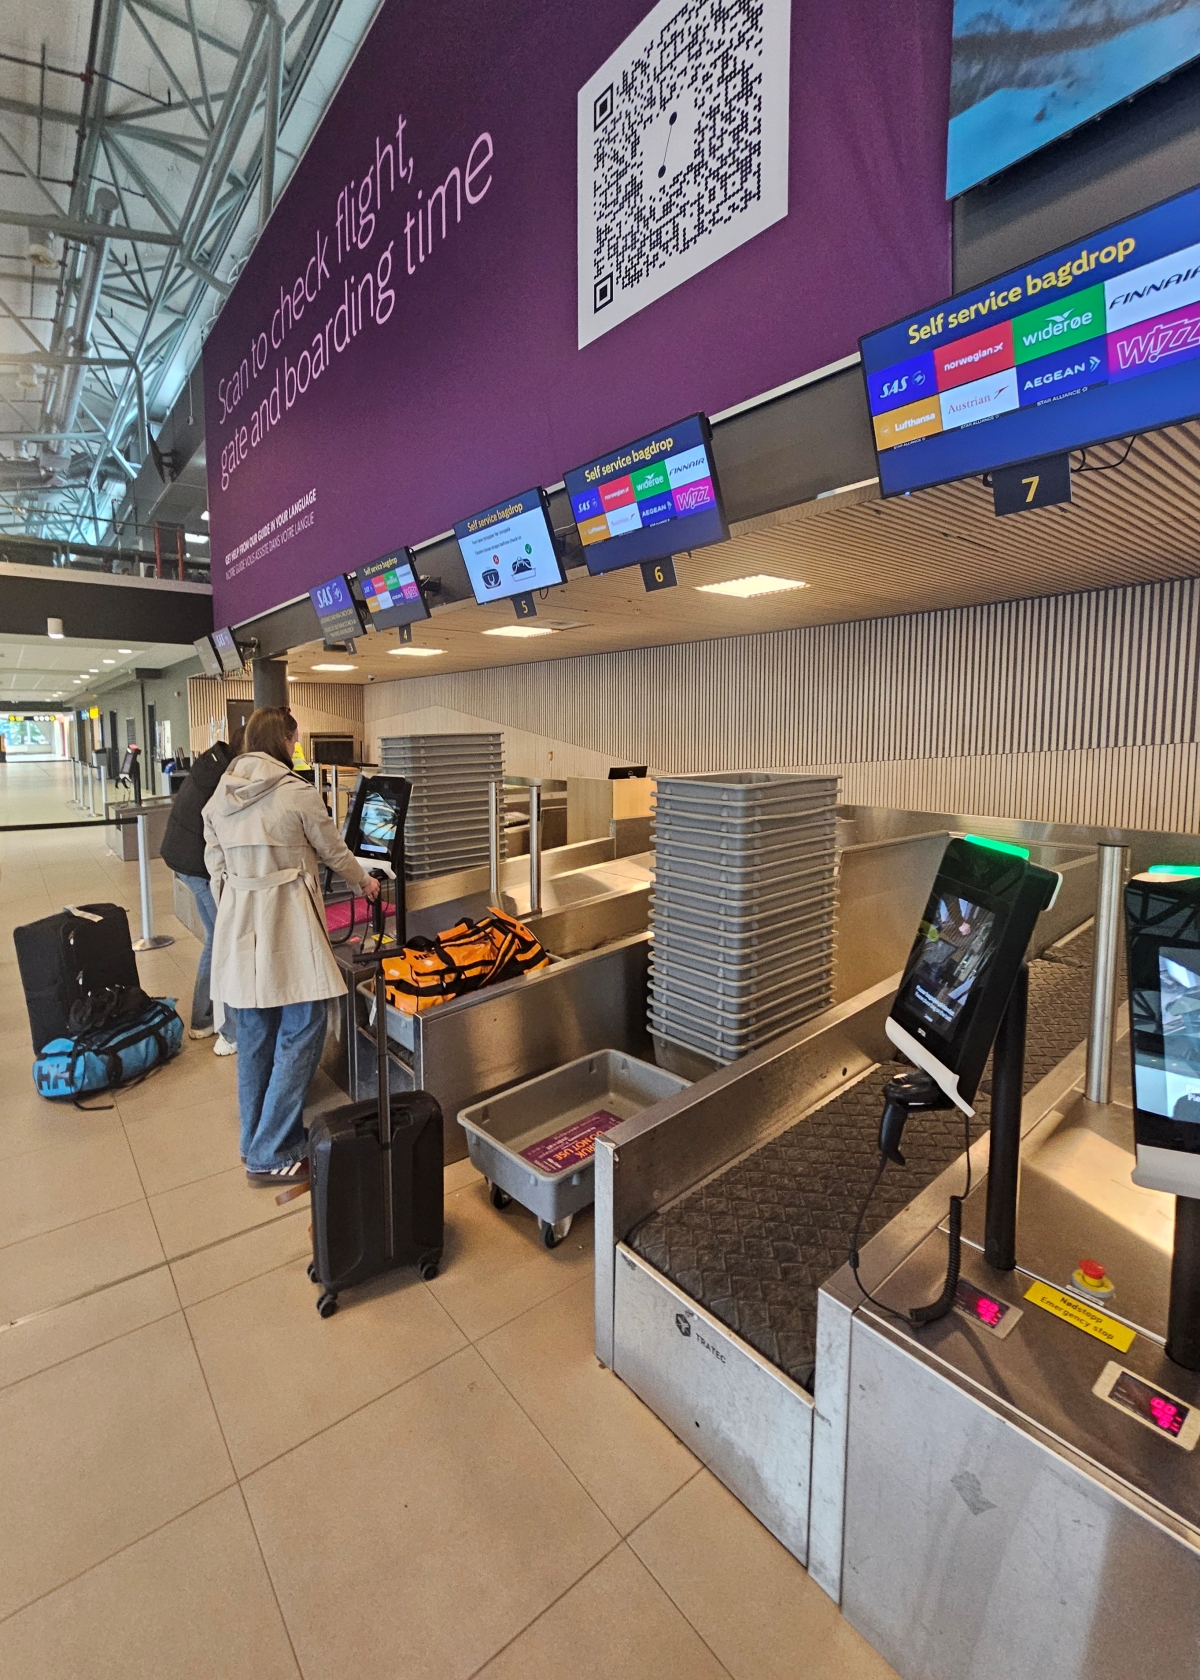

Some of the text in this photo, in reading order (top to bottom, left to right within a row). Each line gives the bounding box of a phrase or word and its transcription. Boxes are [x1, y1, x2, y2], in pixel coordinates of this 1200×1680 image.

[218, 113, 414, 425] Scan to check flight,
[908, 236, 1136, 345] Self service bagdrop
[221, 131, 494, 491] gate and boarding time
[943, 347, 994, 372] norwegian
[879, 375, 909, 399] SAS
[1023, 362, 1086, 391] AEGEAN
[947, 393, 991, 415] Austrian
[1036, 388, 1080, 406] STAR ALLIANCE
[894, 413, 936, 432] Lufthansa
[584, 437, 674, 483] Self service bagdrop
[669, 457, 705, 476] FINNAIR
[1021, 476, 1040, 503] 7
[257, 522, 270, 542] GUIDE
[270, 519, 276, 533] IN
[275, 509, 289, 528] YOUR
[289, 488, 316, 519] LANGUAGE
[467, 503, 523, 532] Self service bagdrop
[578, 500, 590, 513] SAS
[642, 504, 667, 518] AEGEAN
[294, 511, 315, 535] LANGUE
[654, 566, 664, 583] 6
[316, 586, 333, 609] SAS
[521, 600, 529, 614] 5
[403, 629, 408, 641] 4
[552, 1148, 575, 1161] USE
[571, 1137, 592, 1151] NOT
[1040, 1296, 1091, 1329] Emergency
[1092, 1323, 1115, 1341] stop
[1059, 1296, 1104, 1324] Nødstopp
[696, 1333, 726, 1364] TRATEC
